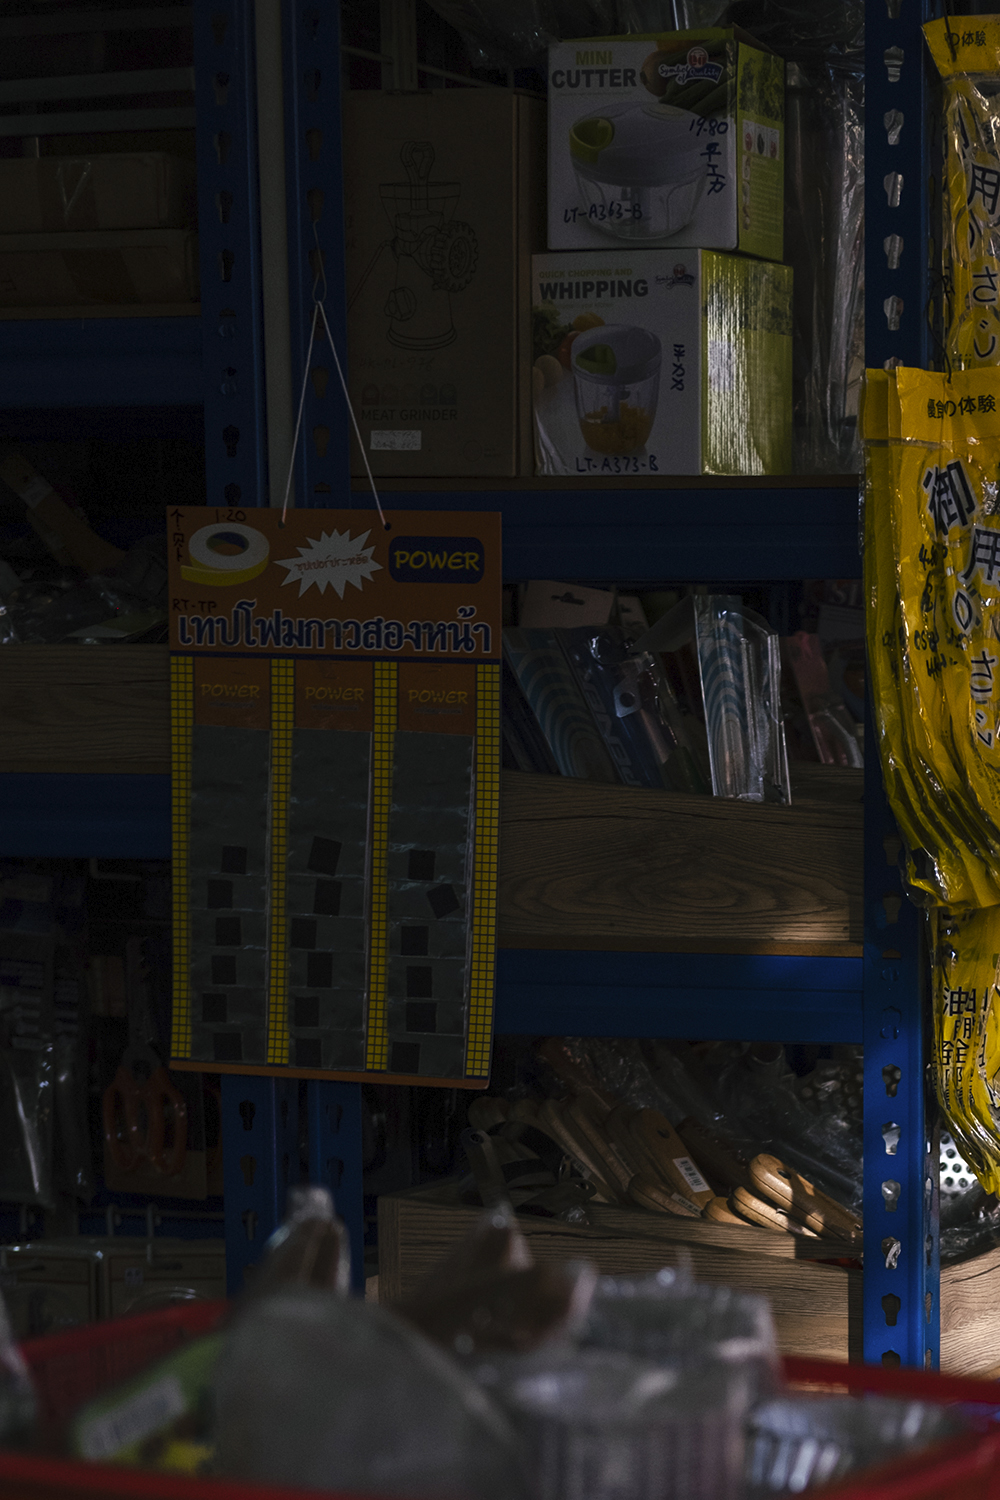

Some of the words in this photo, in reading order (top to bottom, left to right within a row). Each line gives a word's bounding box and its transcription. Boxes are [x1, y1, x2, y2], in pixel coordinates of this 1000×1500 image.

[575, 50, 613, 65] MINI
[552, 68, 637, 89] CUTTER
[660, 65, 689, 76] Symbol
[677, 73, 686, 84] of
[689, 68, 720, 79] Quality
[689, 118, 728, 136] 19.80
[539, 270, 565, 279] QUICK
[567, 268, 612, 278] CHOPPING
[614, 268, 633, 276] AND
[539, 279, 649, 300] WHIPPING
[361, 409, 396, 421] MEAT
[400, 409, 458, 422] GRINDER
[575, 455, 659, 472] LT-A373-B
[394, 550, 480, 571] POWER
[178, 598, 492, 653] เทปโฟมกาวสองหน้า
[200, 683, 260, 699] POWER
[304, 686, 365, 701] POWER
[408, 689, 469, 704] POWER
